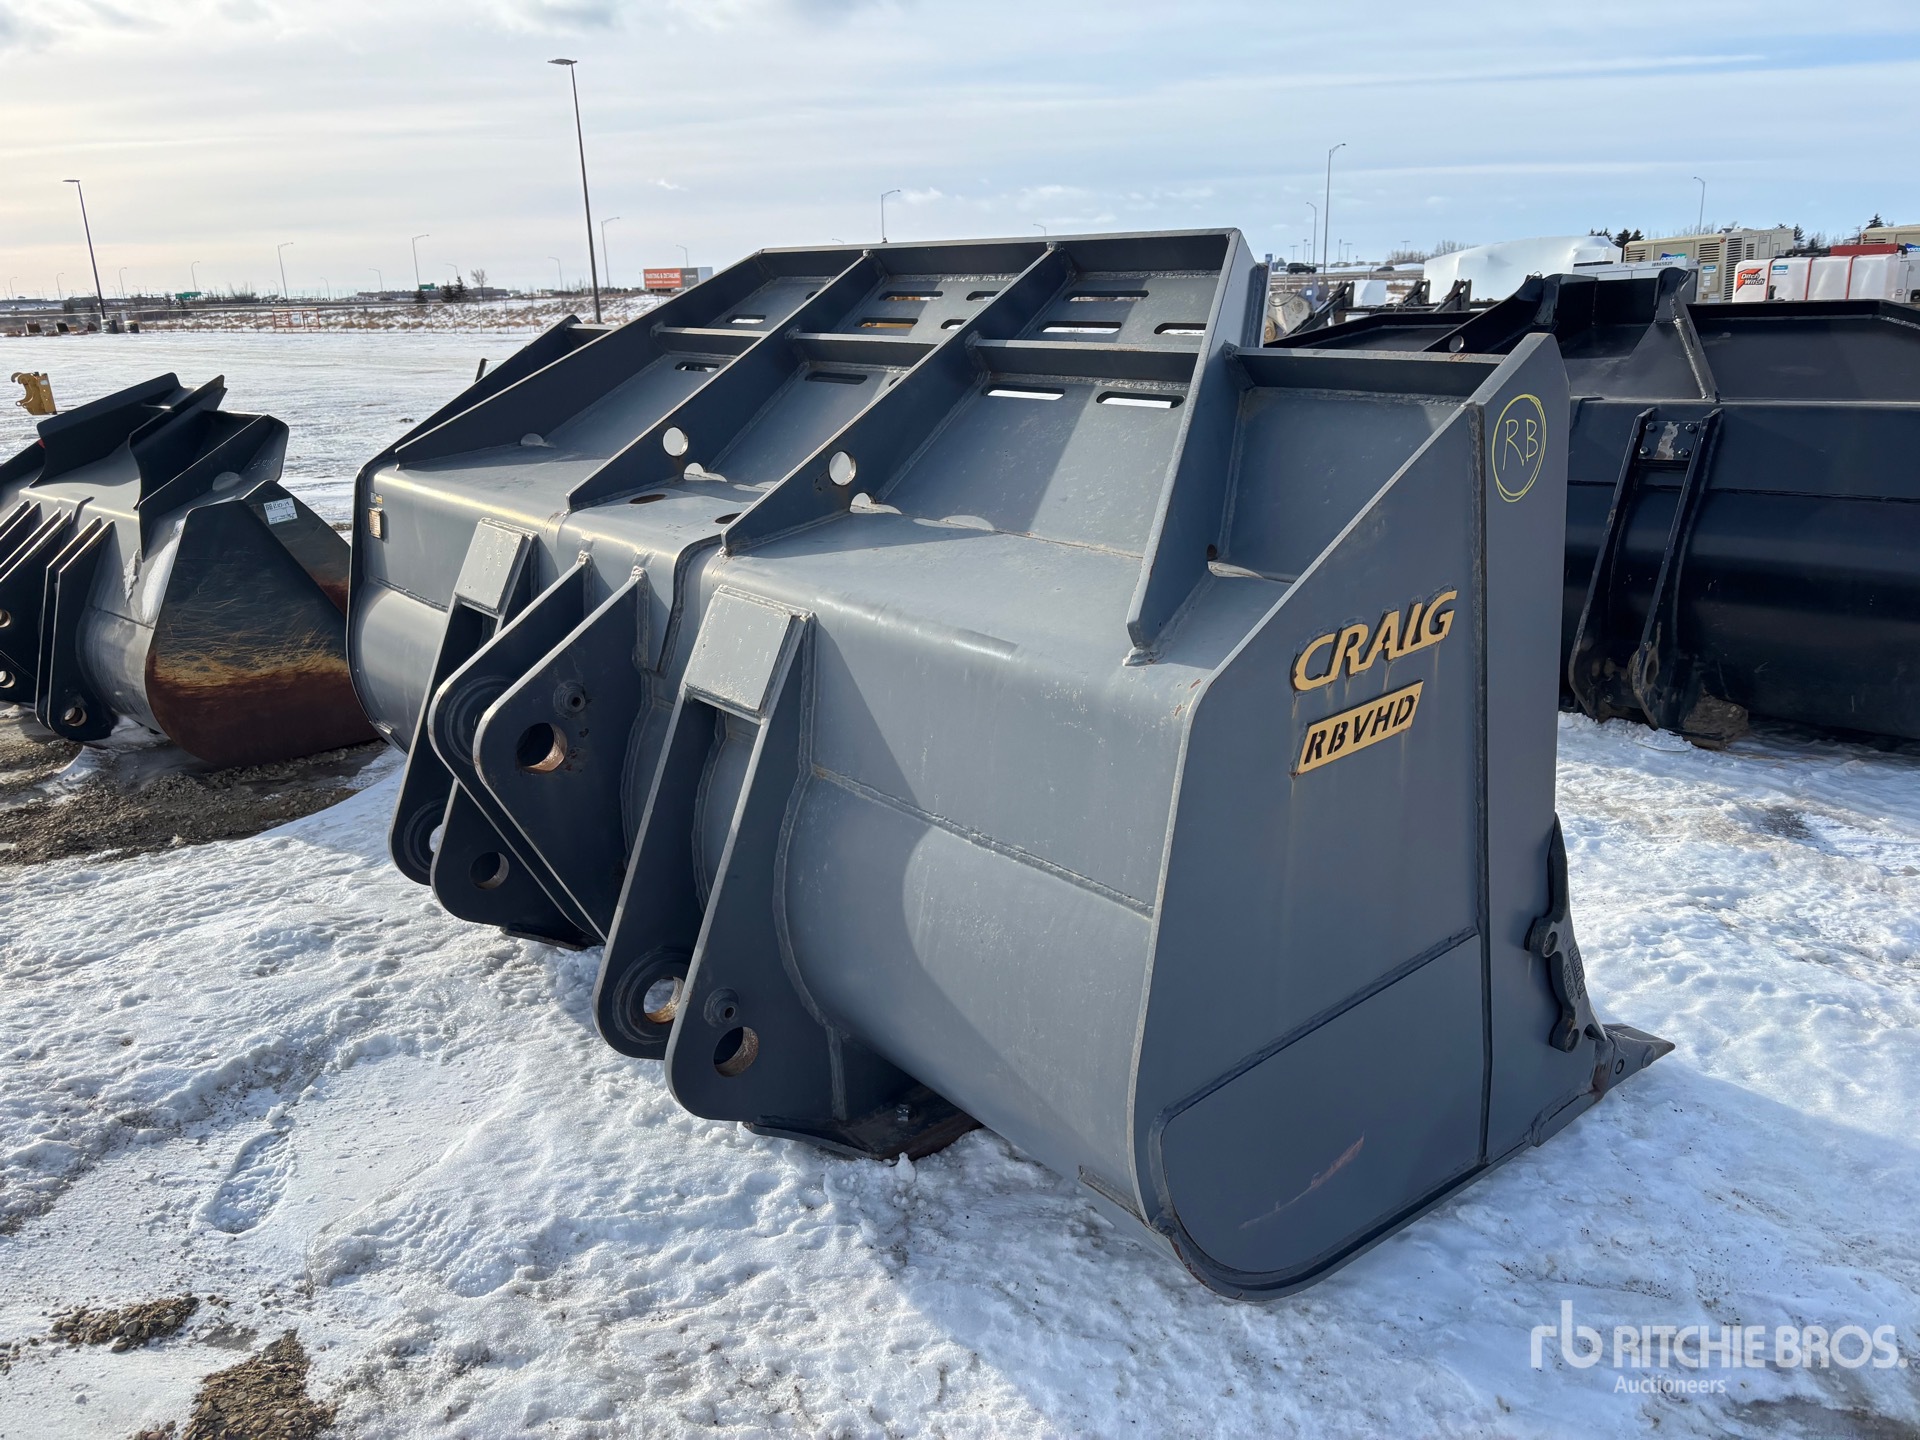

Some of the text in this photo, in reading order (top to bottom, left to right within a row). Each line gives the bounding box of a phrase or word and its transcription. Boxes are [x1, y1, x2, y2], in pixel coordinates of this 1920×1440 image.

[1503, 419, 1538, 471] RB
[1290, 588, 1458, 692] CRAIG
[1303, 693, 1416, 766] RBVHD
